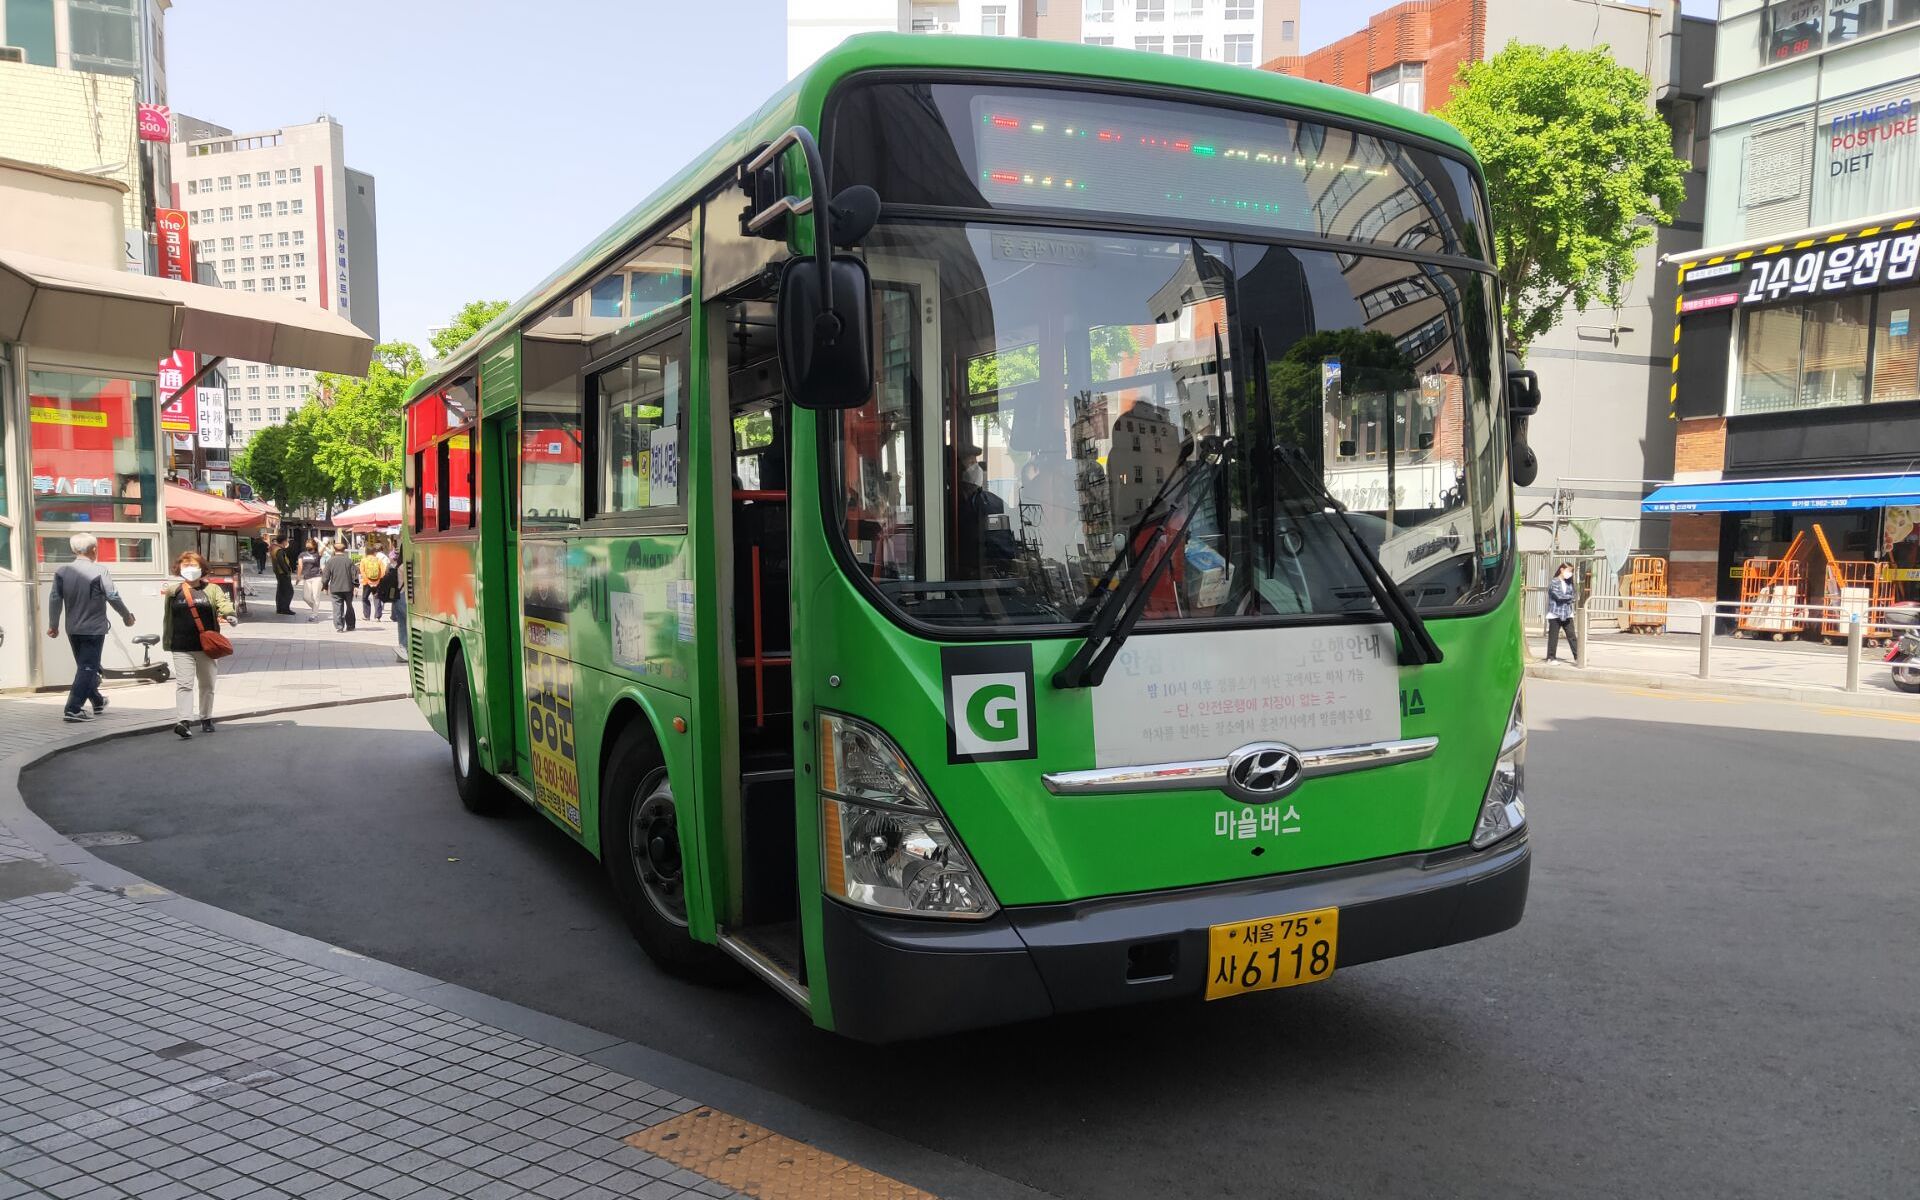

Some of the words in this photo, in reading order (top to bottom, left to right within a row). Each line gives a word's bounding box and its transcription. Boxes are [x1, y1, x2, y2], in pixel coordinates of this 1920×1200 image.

[1832, 98, 1912, 132] FITNESS
[1831, 117, 1917, 152] POSTURE
[1831, 153, 1873, 177] DIET
[160, 219, 180, 230] the
[200, 392, 212, 442] 마라탕
[1310, 634, 1381, 662] 운행안내
[1146, 682, 1158, 699] 밤
[1162, 681, 1187, 697] 10시
[1192, 680, 1213, 695] 이후
[1347, 668, 1366, 682] 가능
[966, 683, 1019, 742] G
[1198, 698, 1257, 716] 안전운행에
[1262, 696, 1295, 711] 지장이
[1300, 693, 1321, 708] 없는
[1325, 691, 1335, 705] 곳
[1400, 688, 1426, 718] 스
[1215, 805, 1301, 840] 마을버스
[1243, 922, 1274, 945] 서울
[1280, 917, 1309, 940] 75
